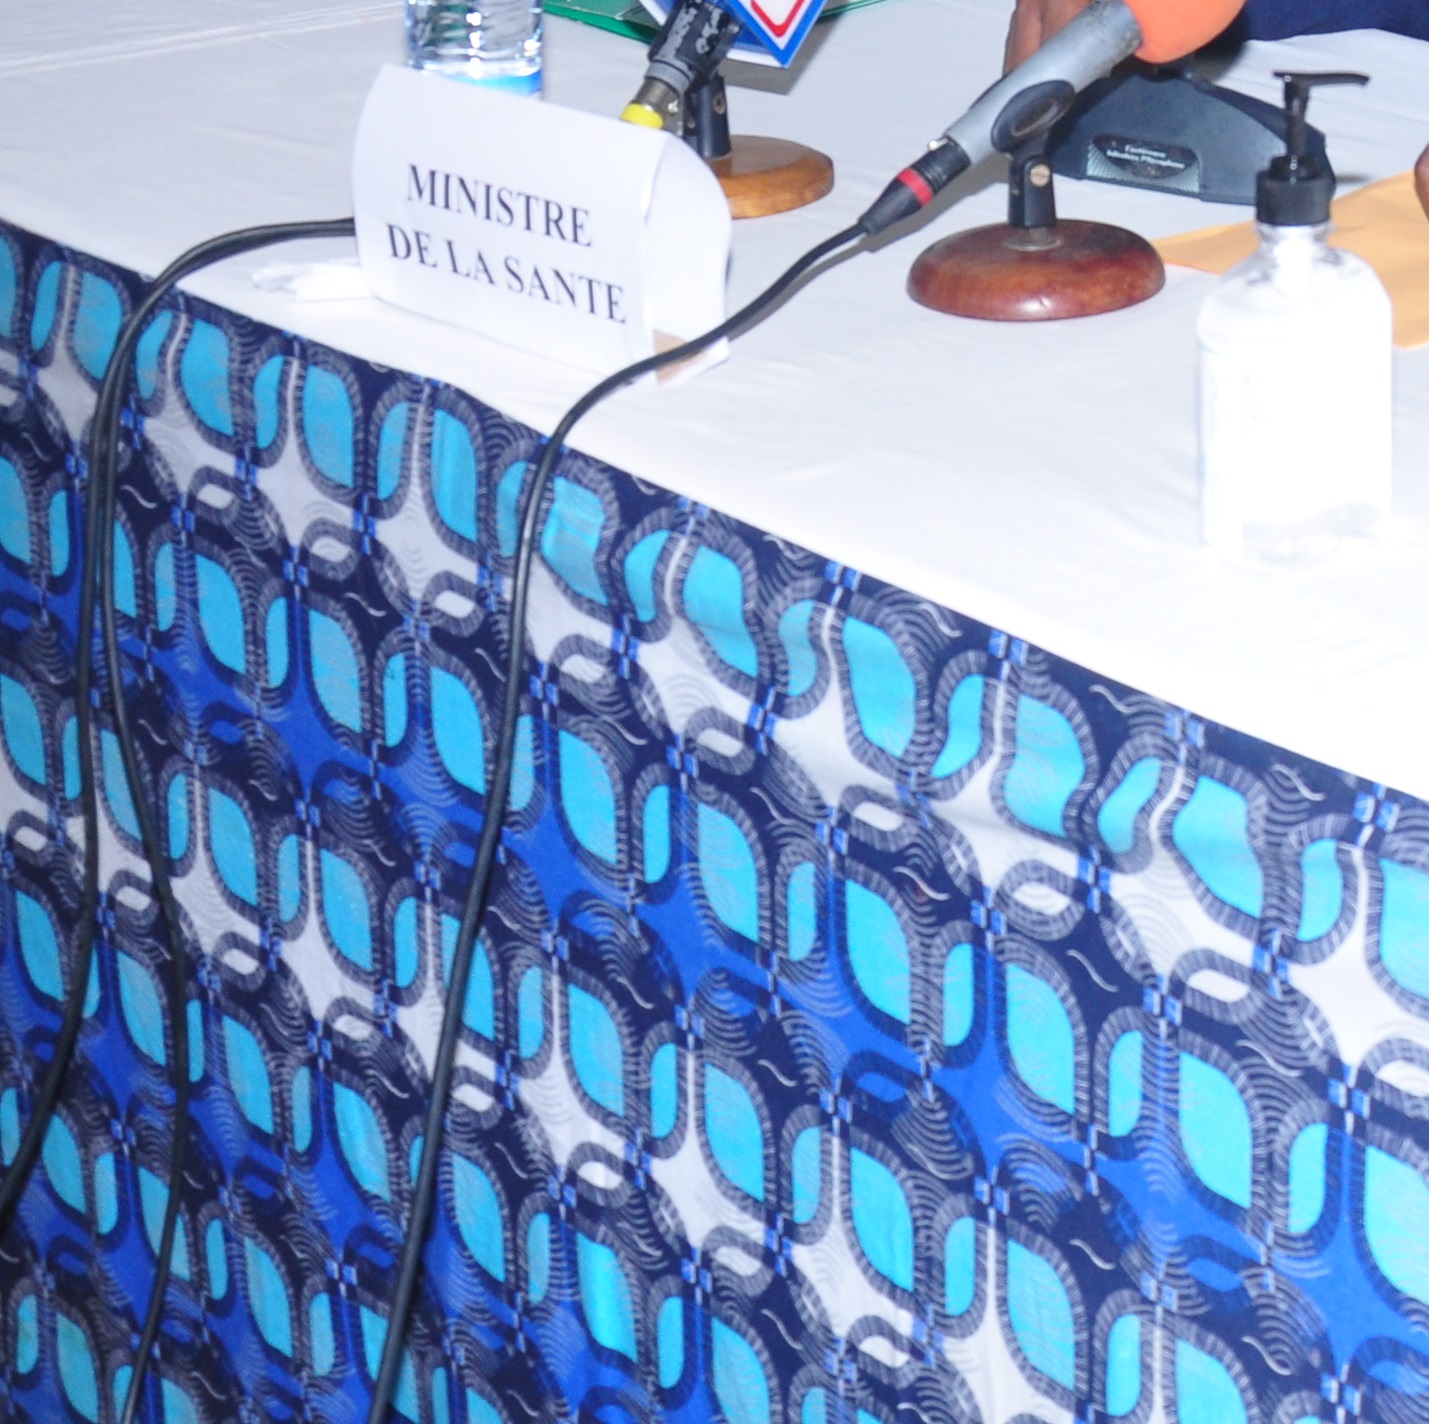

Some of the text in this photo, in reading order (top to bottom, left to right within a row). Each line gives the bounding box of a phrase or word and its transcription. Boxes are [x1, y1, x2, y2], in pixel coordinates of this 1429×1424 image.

[407, 163, 593, 248] MINISTRE
[386, 223, 626, 325] DE LA SANTE
